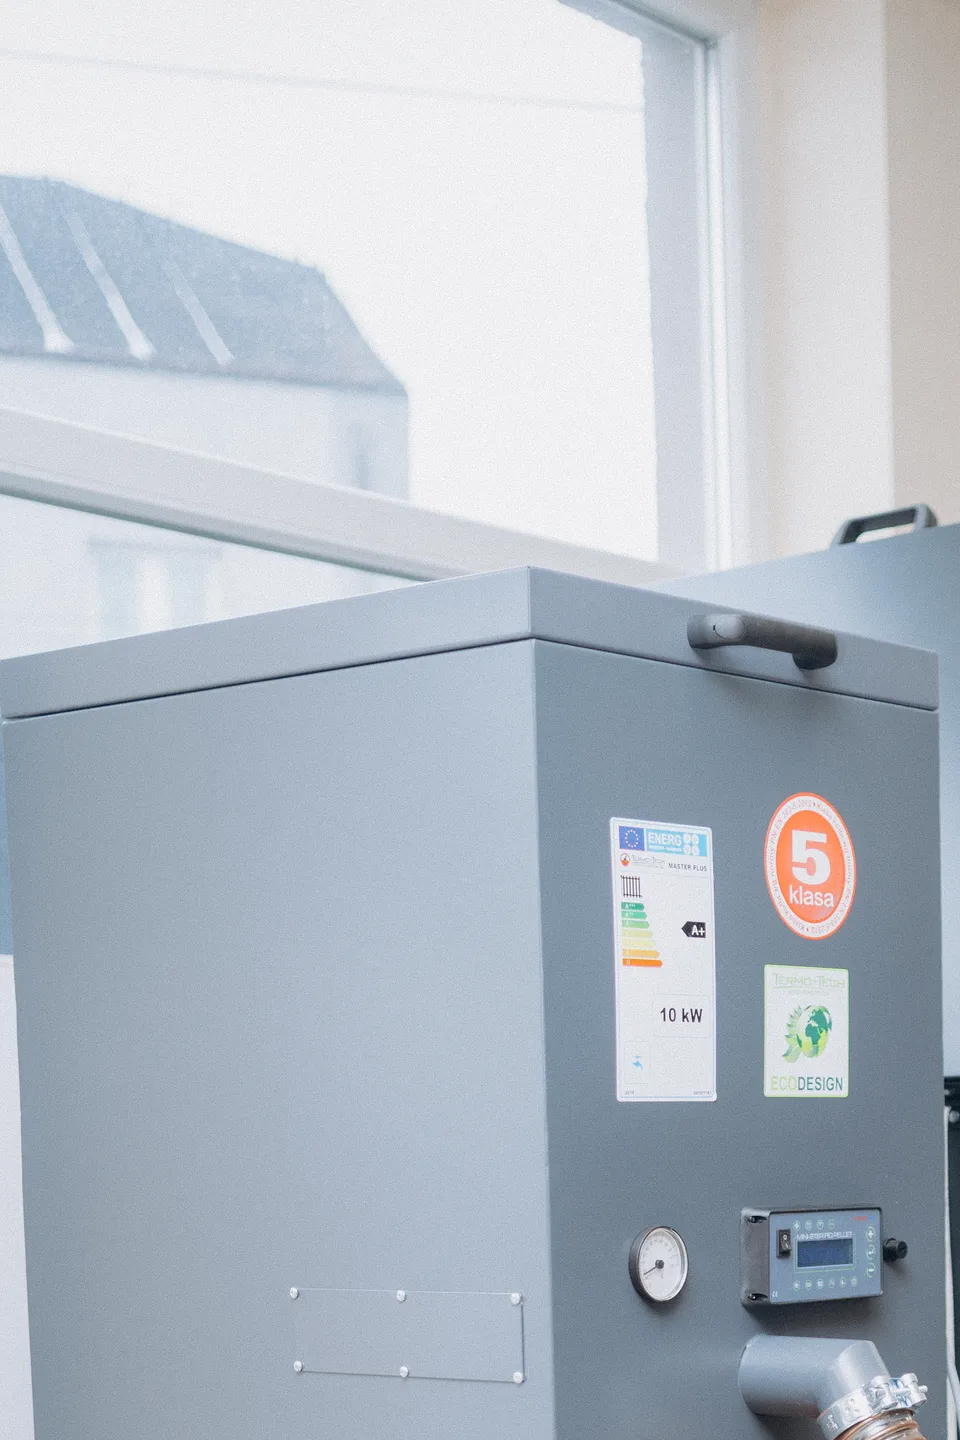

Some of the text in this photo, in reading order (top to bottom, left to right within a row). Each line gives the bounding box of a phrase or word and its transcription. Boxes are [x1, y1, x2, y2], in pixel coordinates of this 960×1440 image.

[648, 832, 682, 847] ENERG
[791, 829, 831, 886] 5
[668, 862, 692, 871] MASTER
[693, 864, 708, 872] PLUS
[788, 884, 835, 908] klasa
[691, 924, 705, 936] A+
[660, 1007, 703, 1023] 10 kW
[770, 1075, 843, 1091] ECODESIGN
